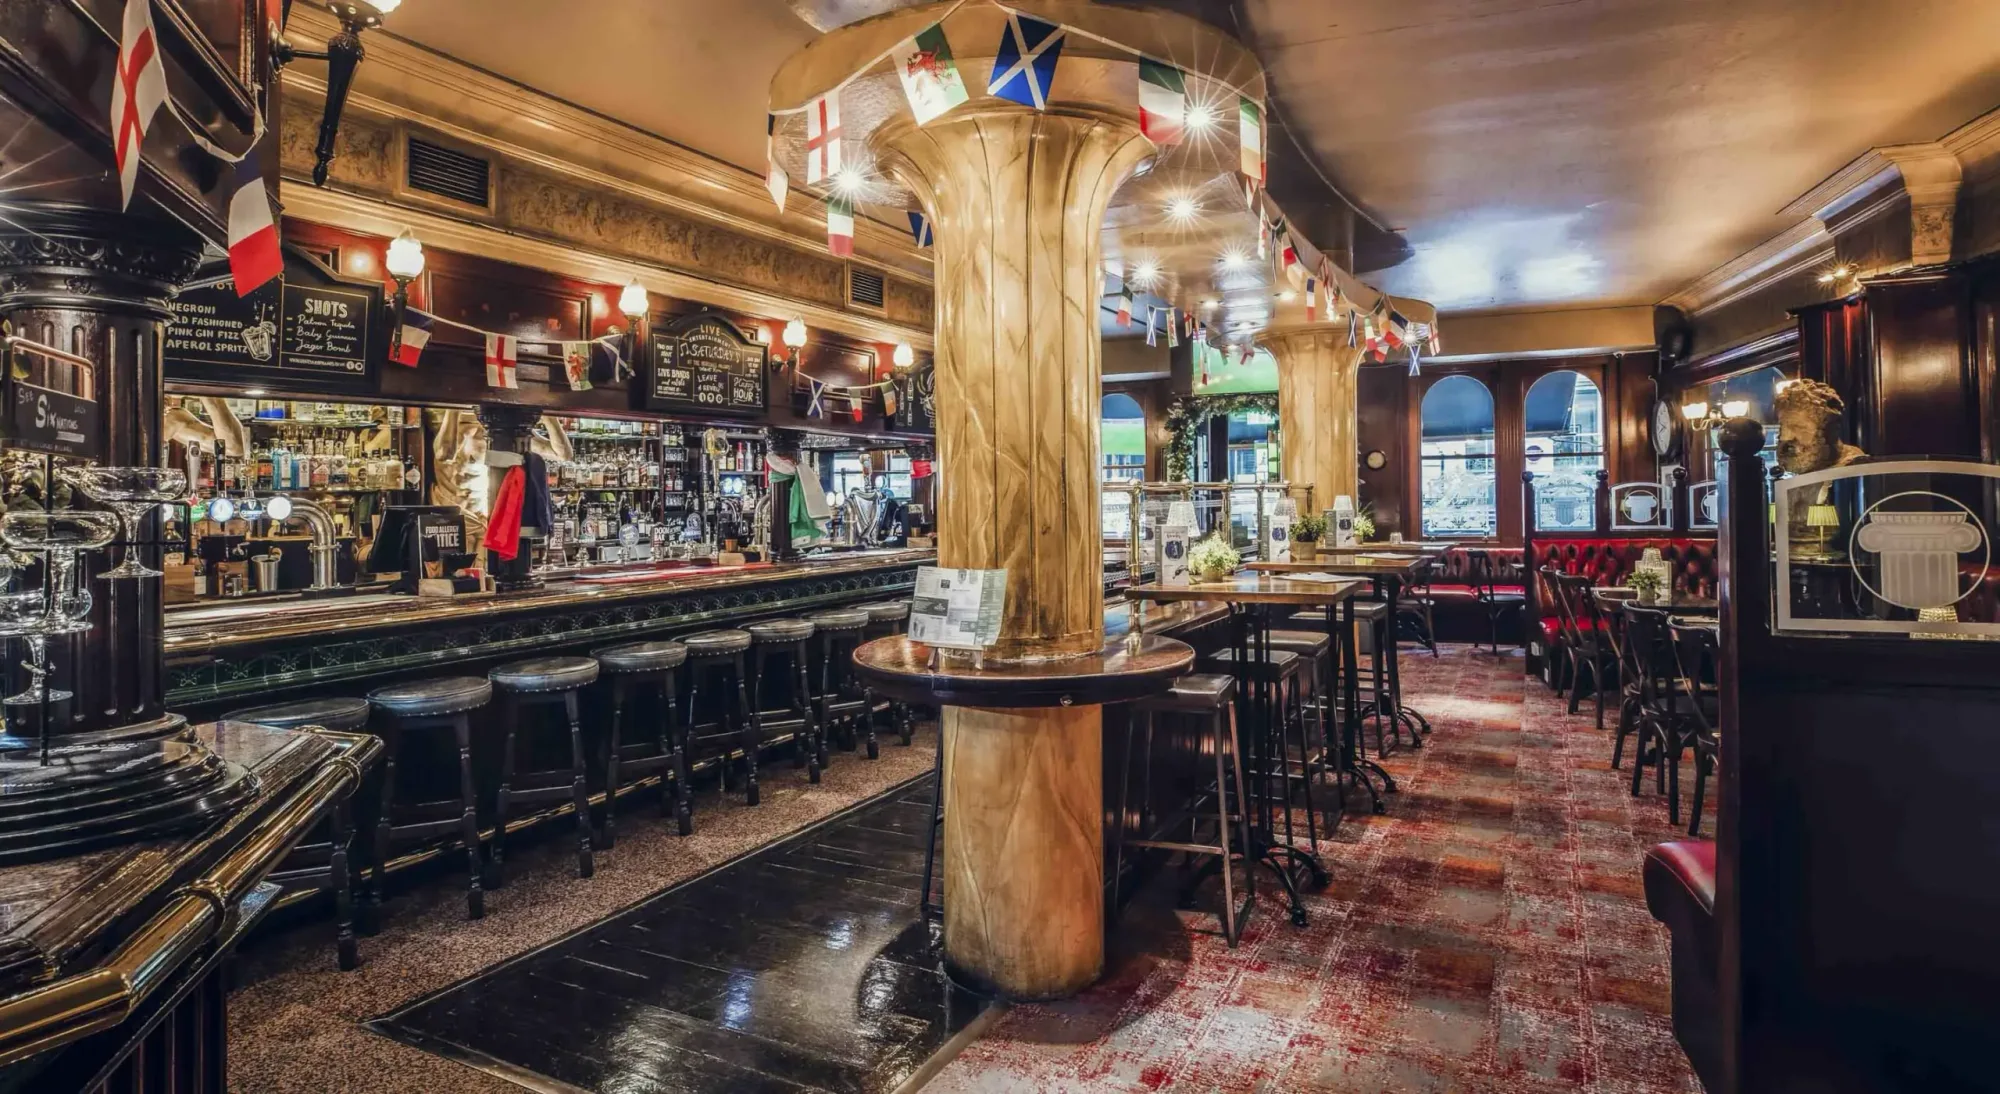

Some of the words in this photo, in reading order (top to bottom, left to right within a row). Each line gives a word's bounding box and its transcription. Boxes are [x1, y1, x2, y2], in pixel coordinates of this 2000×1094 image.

[168, 302, 216, 314] NEGRONI
[305, 298, 348, 318] SHOTS
[192, 317, 243, 329] FASHIONED
[167, 327, 193, 337] PINK
[195, 329, 214, 338] GIN
[217, 331, 240, 340] FIZZ
[296, 325, 322, 340] Baby
[700, 324, 720, 336] LIVE
[166, 339, 212, 351] APEROL
[214, 342, 248, 353] SPRITZ
[657, 368, 670, 377] LIVE
[671, 369, 690, 379] BANDS
[697, 374, 718, 383] LEAVE
[733, 388, 754, 402] HOUR
[56, 417, 79, 430] NATIONS
[425, 526, 438, 534] FOOD
[438, 525, 459, 534] ALLERGY
[436, 533, 460, 548] TICE
